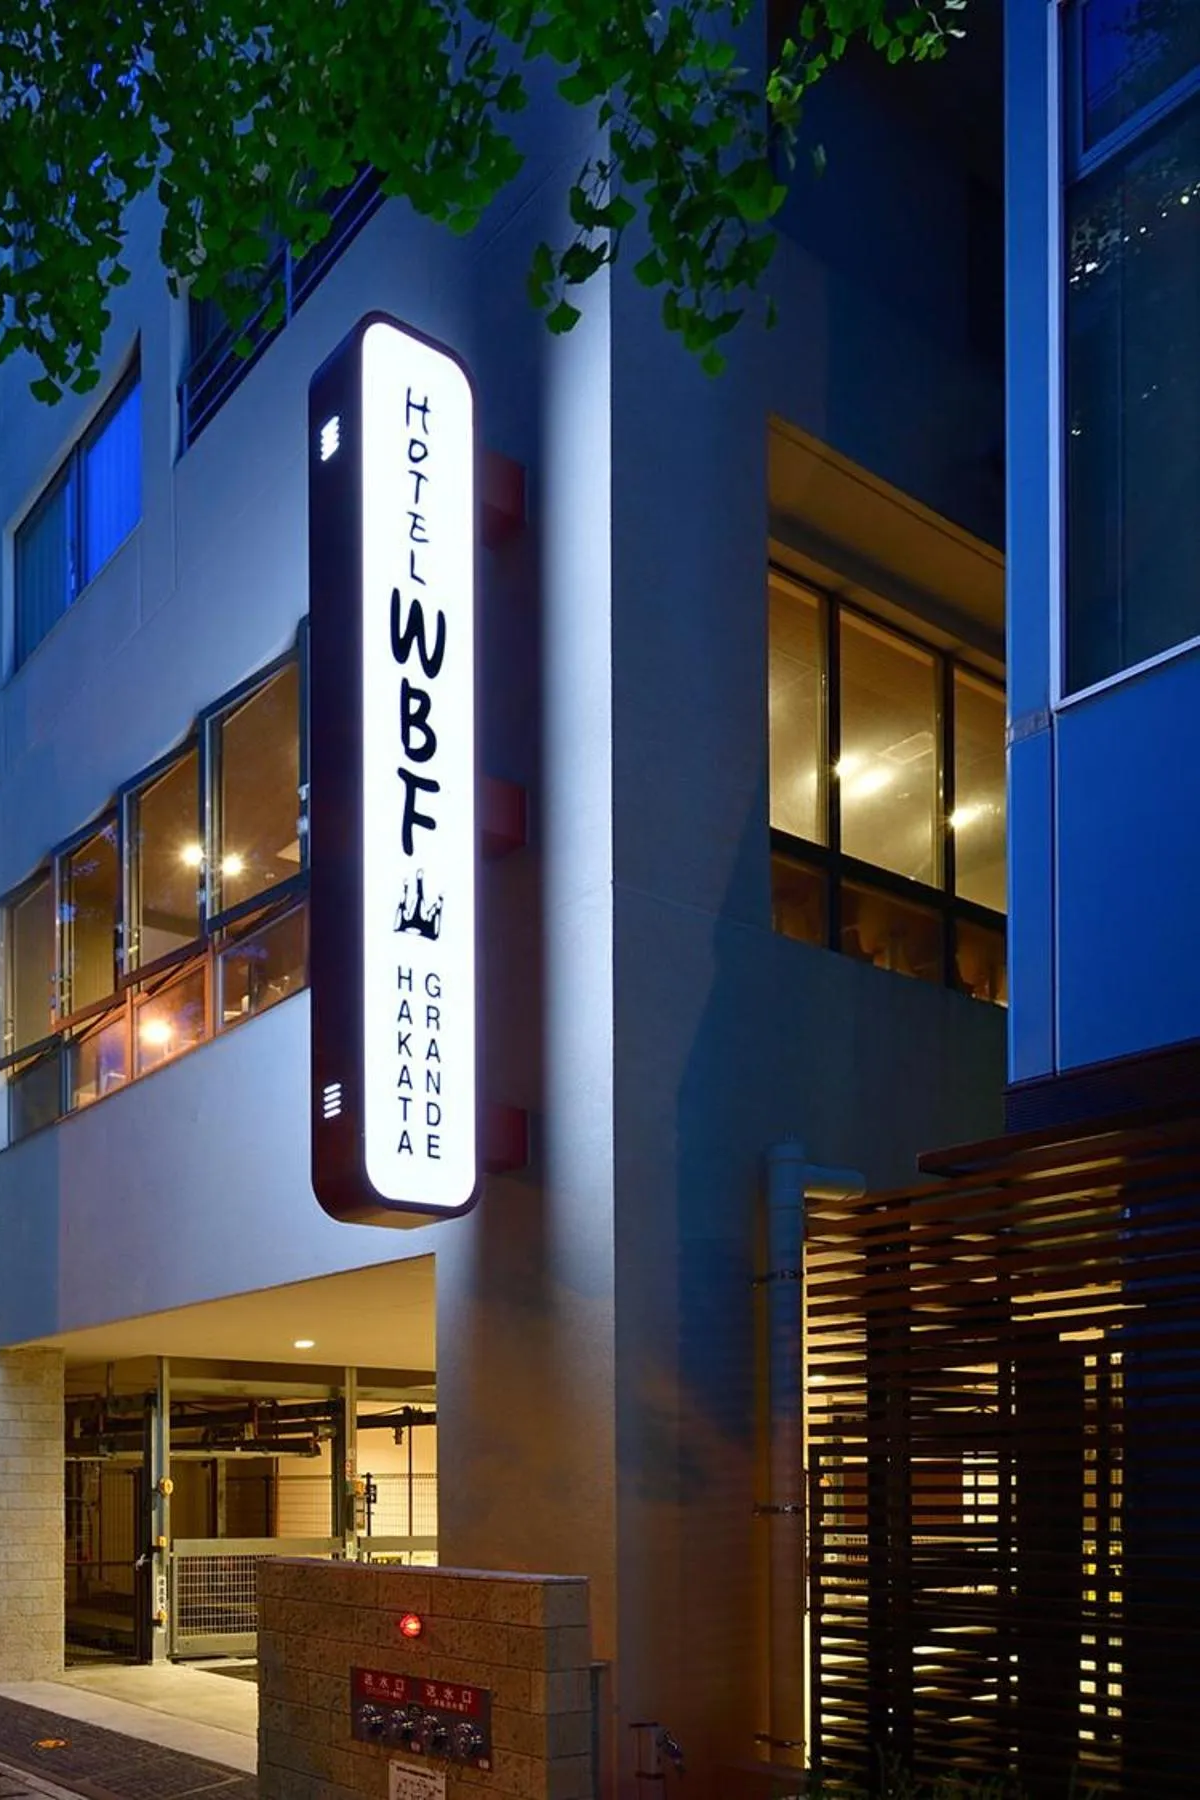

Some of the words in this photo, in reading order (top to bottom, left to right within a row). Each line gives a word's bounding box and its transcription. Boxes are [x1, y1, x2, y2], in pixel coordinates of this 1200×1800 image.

[405, 386, 431, 585] HOTEL
[389, 586, 448, 857] WBF
[397, 965, 414, 1156] HAKATA
[424, 972, 442, 1161] GRANDE
